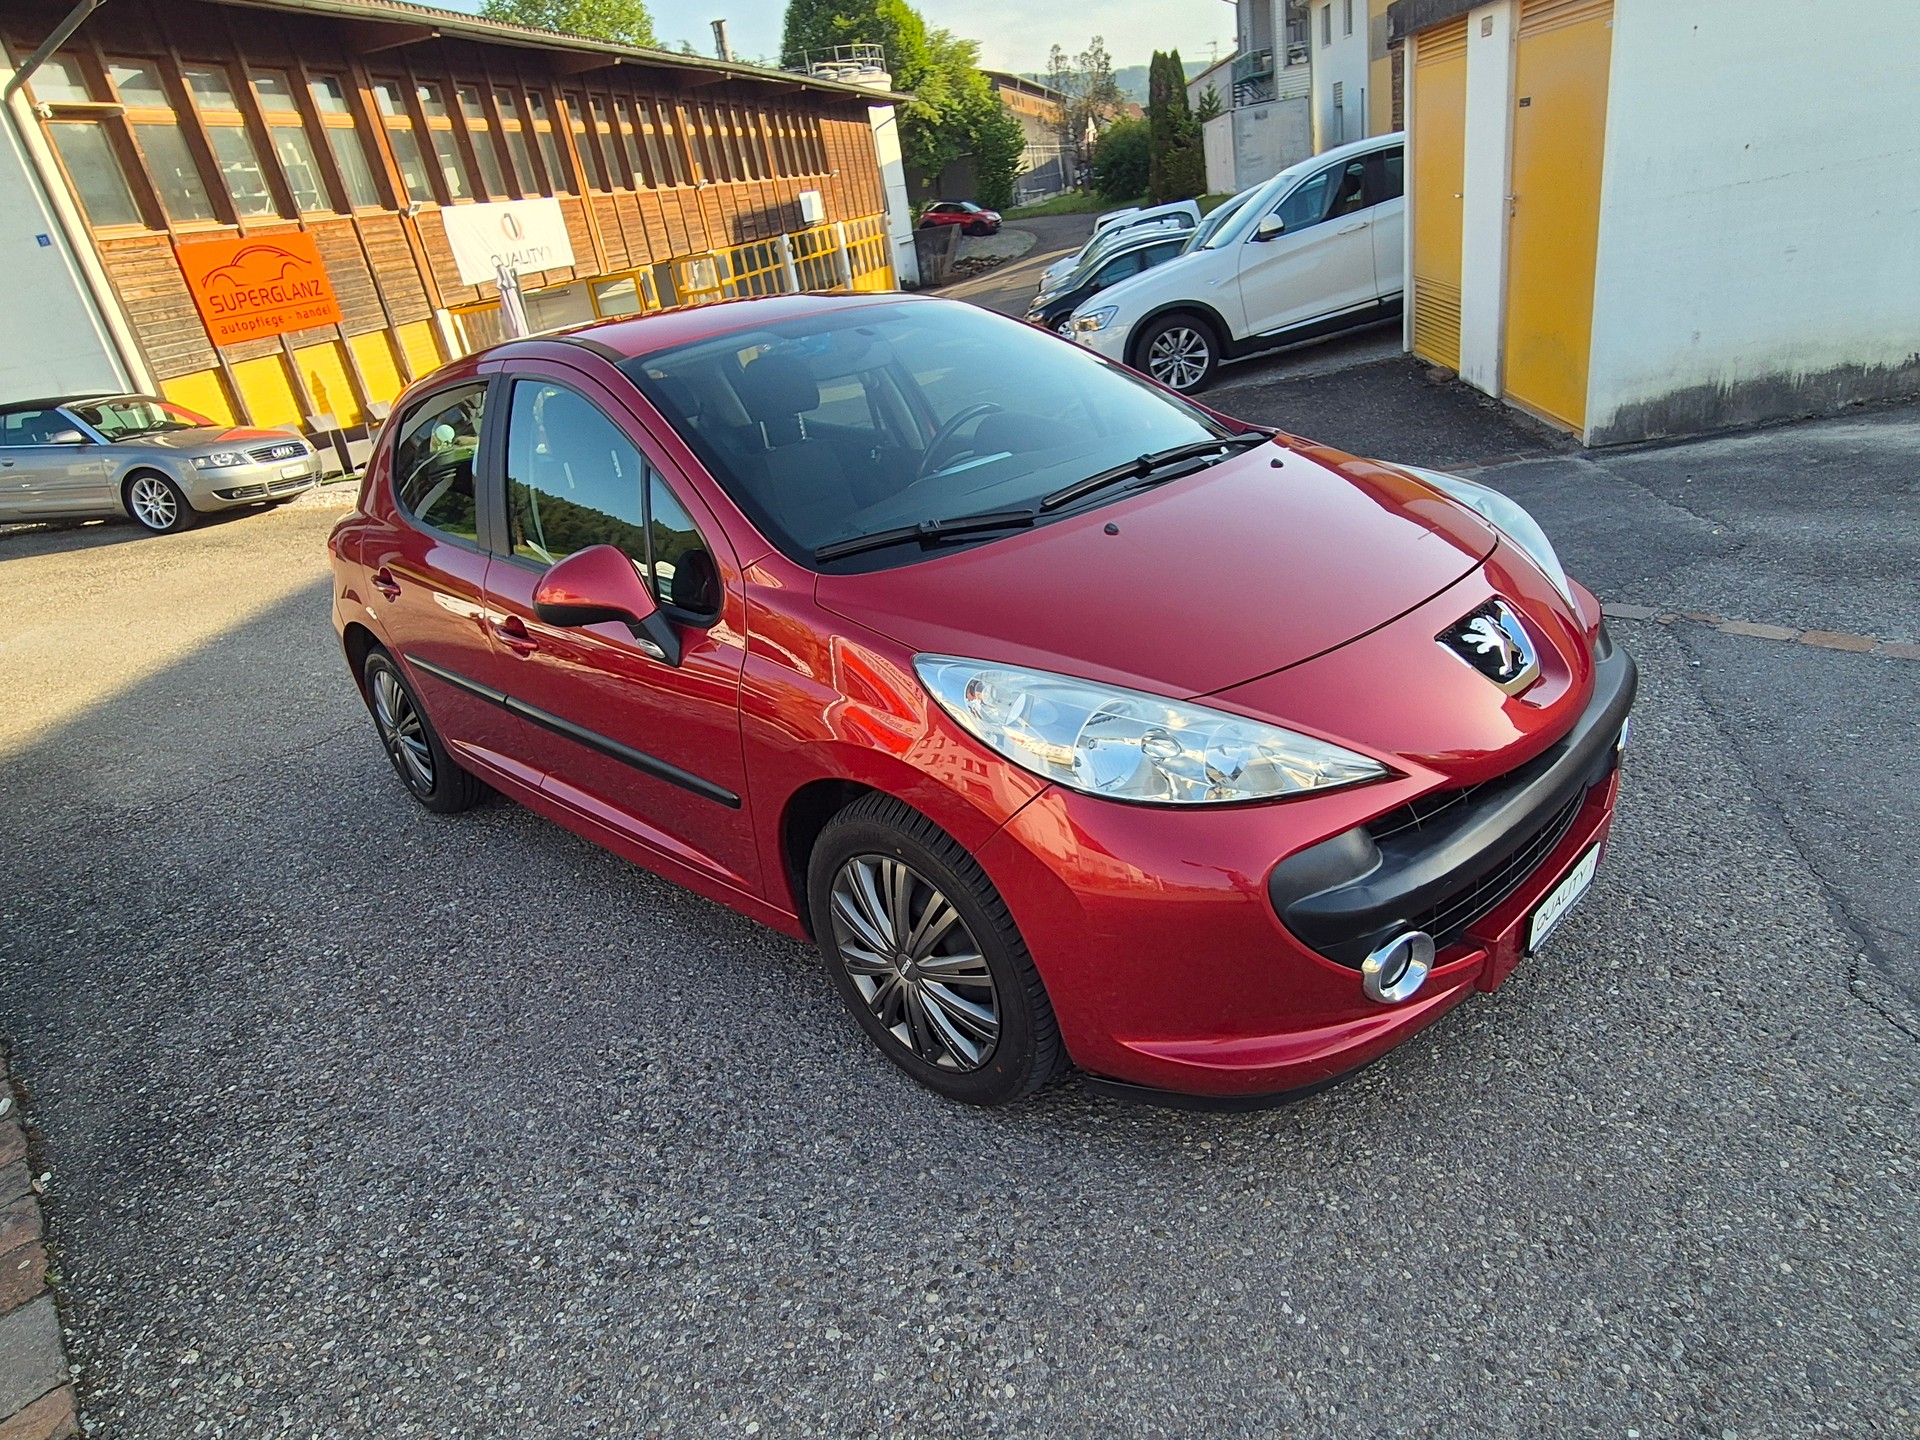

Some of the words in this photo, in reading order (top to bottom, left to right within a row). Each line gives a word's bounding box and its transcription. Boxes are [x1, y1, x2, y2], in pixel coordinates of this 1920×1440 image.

[210, 279, 324, 314] SUPERGLANZ
[221, 315, 285, 335] autopflege
[297, 304, 332, 321] handel
